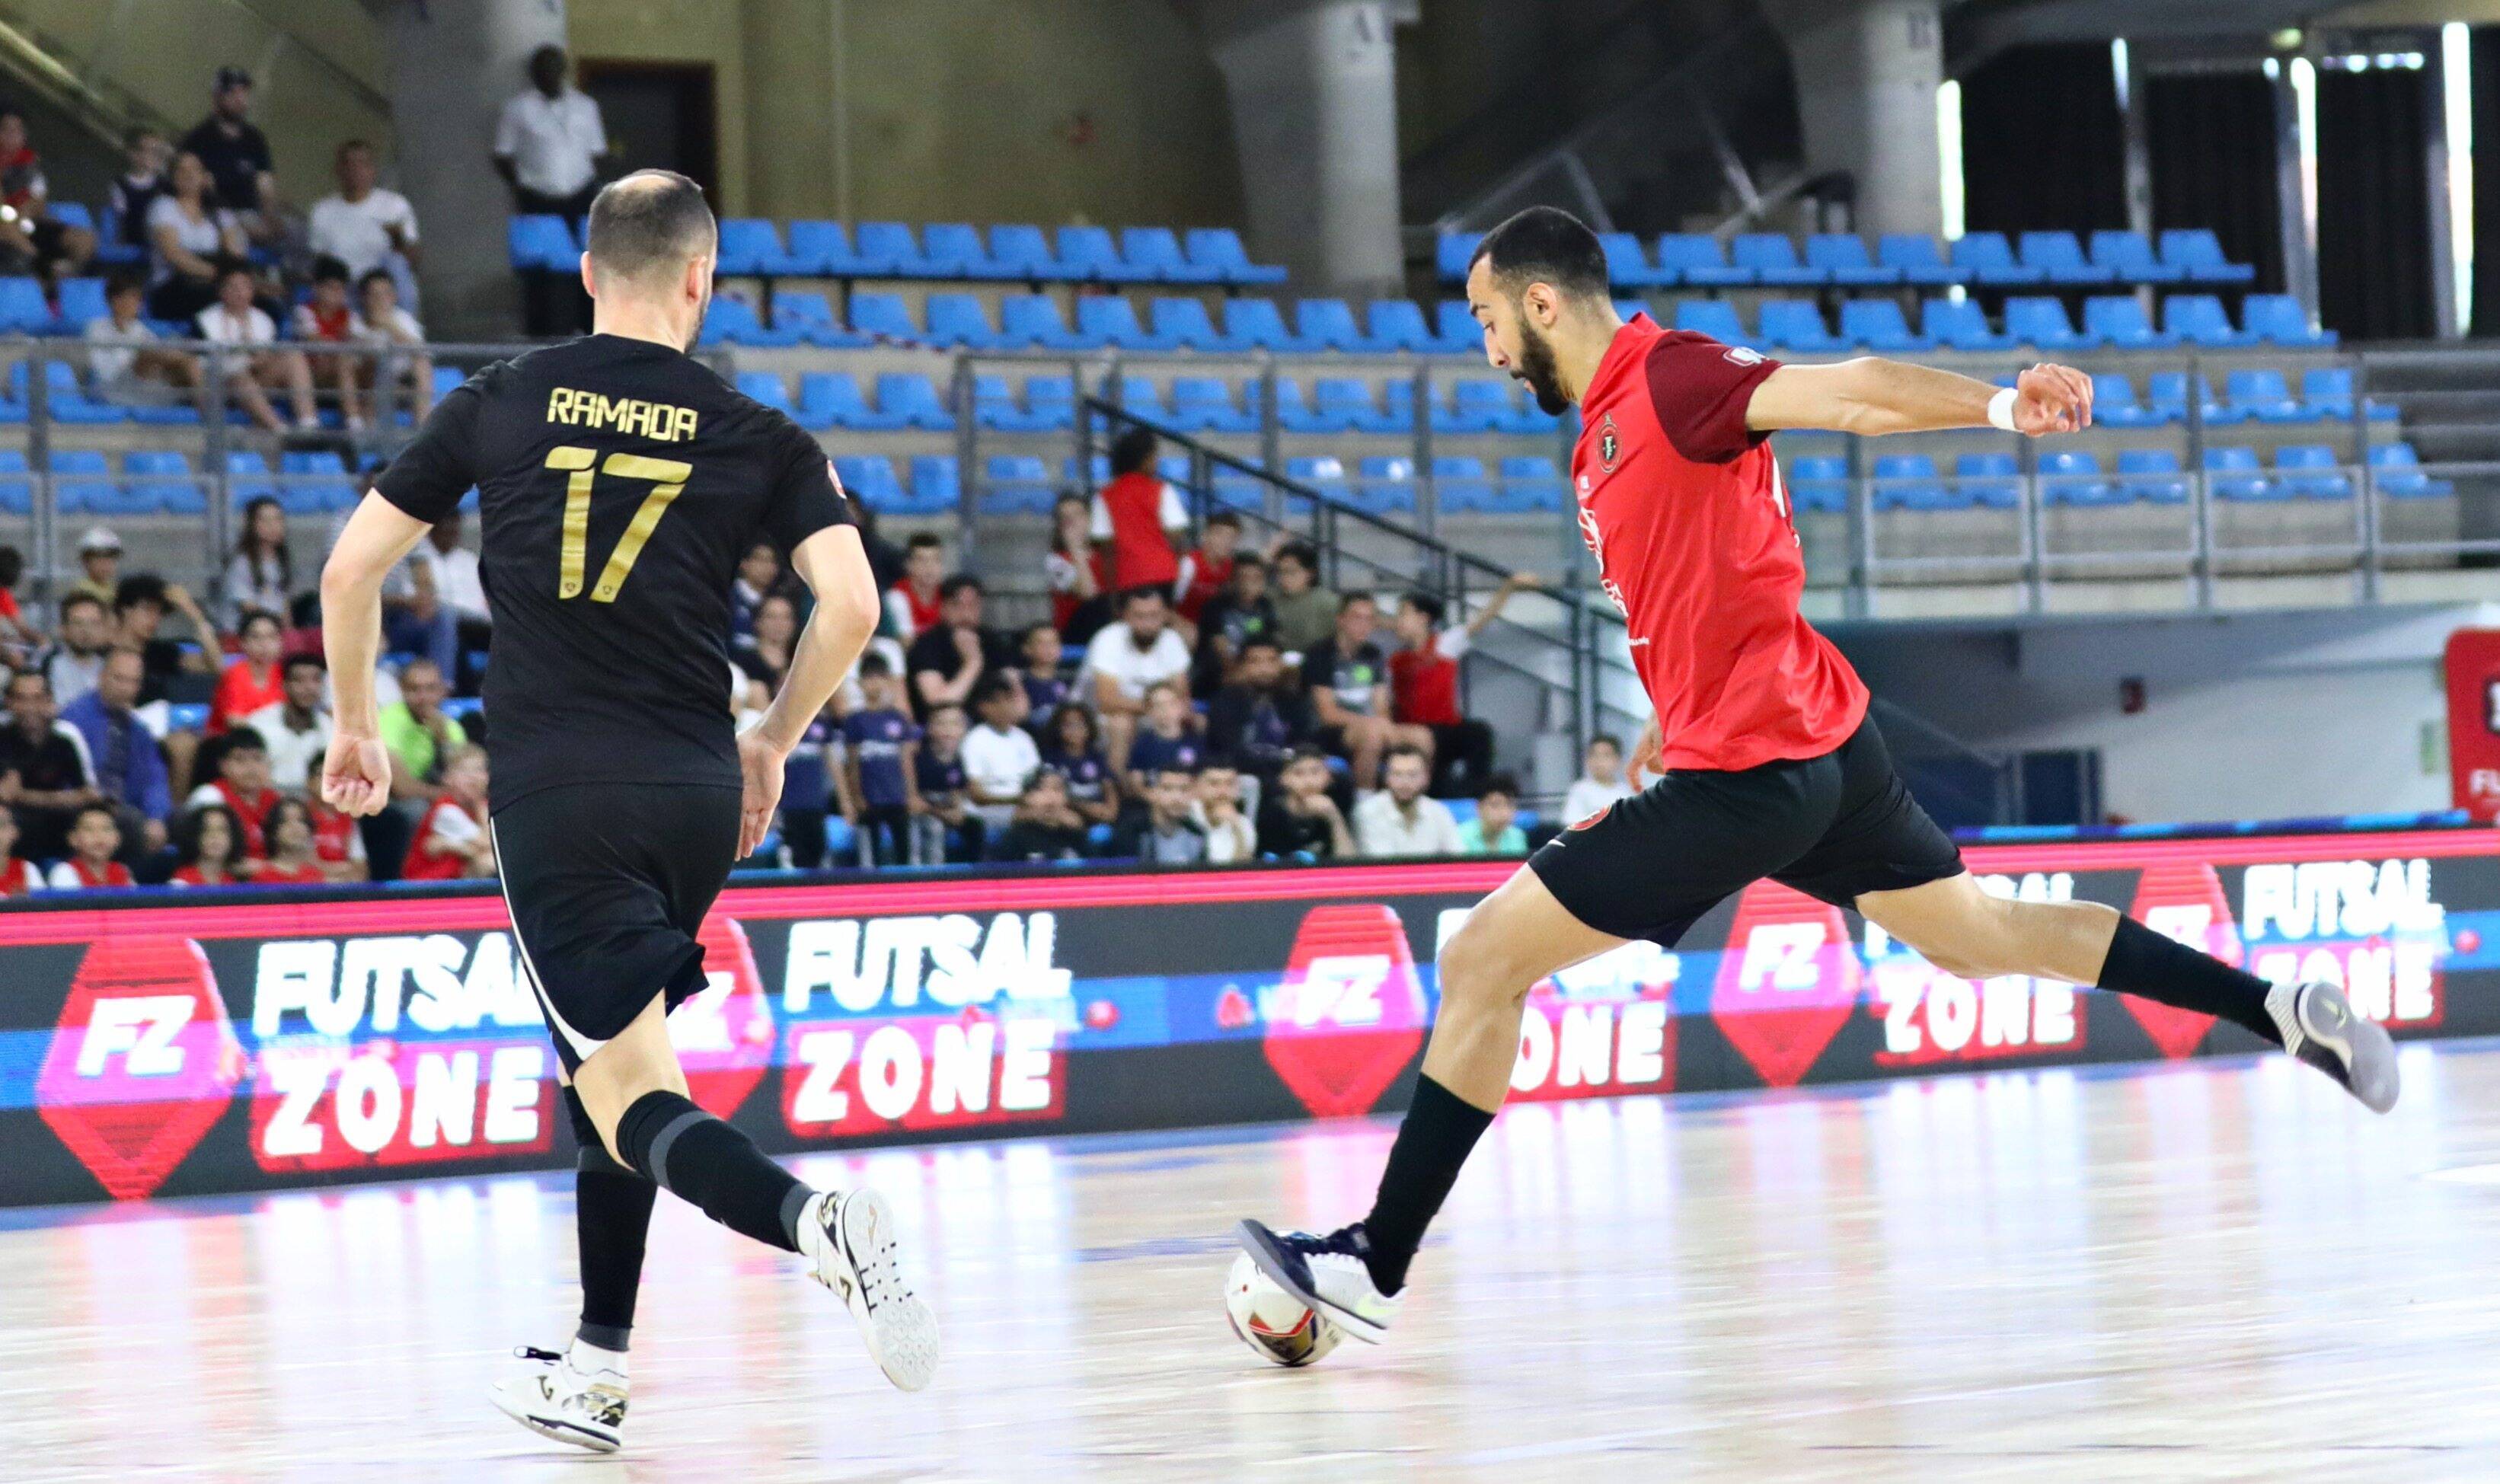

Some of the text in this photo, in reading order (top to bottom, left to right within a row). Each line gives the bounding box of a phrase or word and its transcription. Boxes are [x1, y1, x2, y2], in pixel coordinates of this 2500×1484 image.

[547, 387, 698, 442] RAMADA
[544, 445, 693, 603] 17
[2243, 858, 2443, 940] FUTSAL
[783, 911, 1072, 1013] FUTSAL
[1292, 954, 1391, 1029] FZ
[1739, 922, 1825, 991] FZ
[77, 994, 196, 1077] FZ
[665, 972, 735, 1050] Z
[1876, 974, 2076, 1052] ZONE
[263, 1045, 544, 1155] ZONE
[793, 1019, 1056, 1123] ZONE
